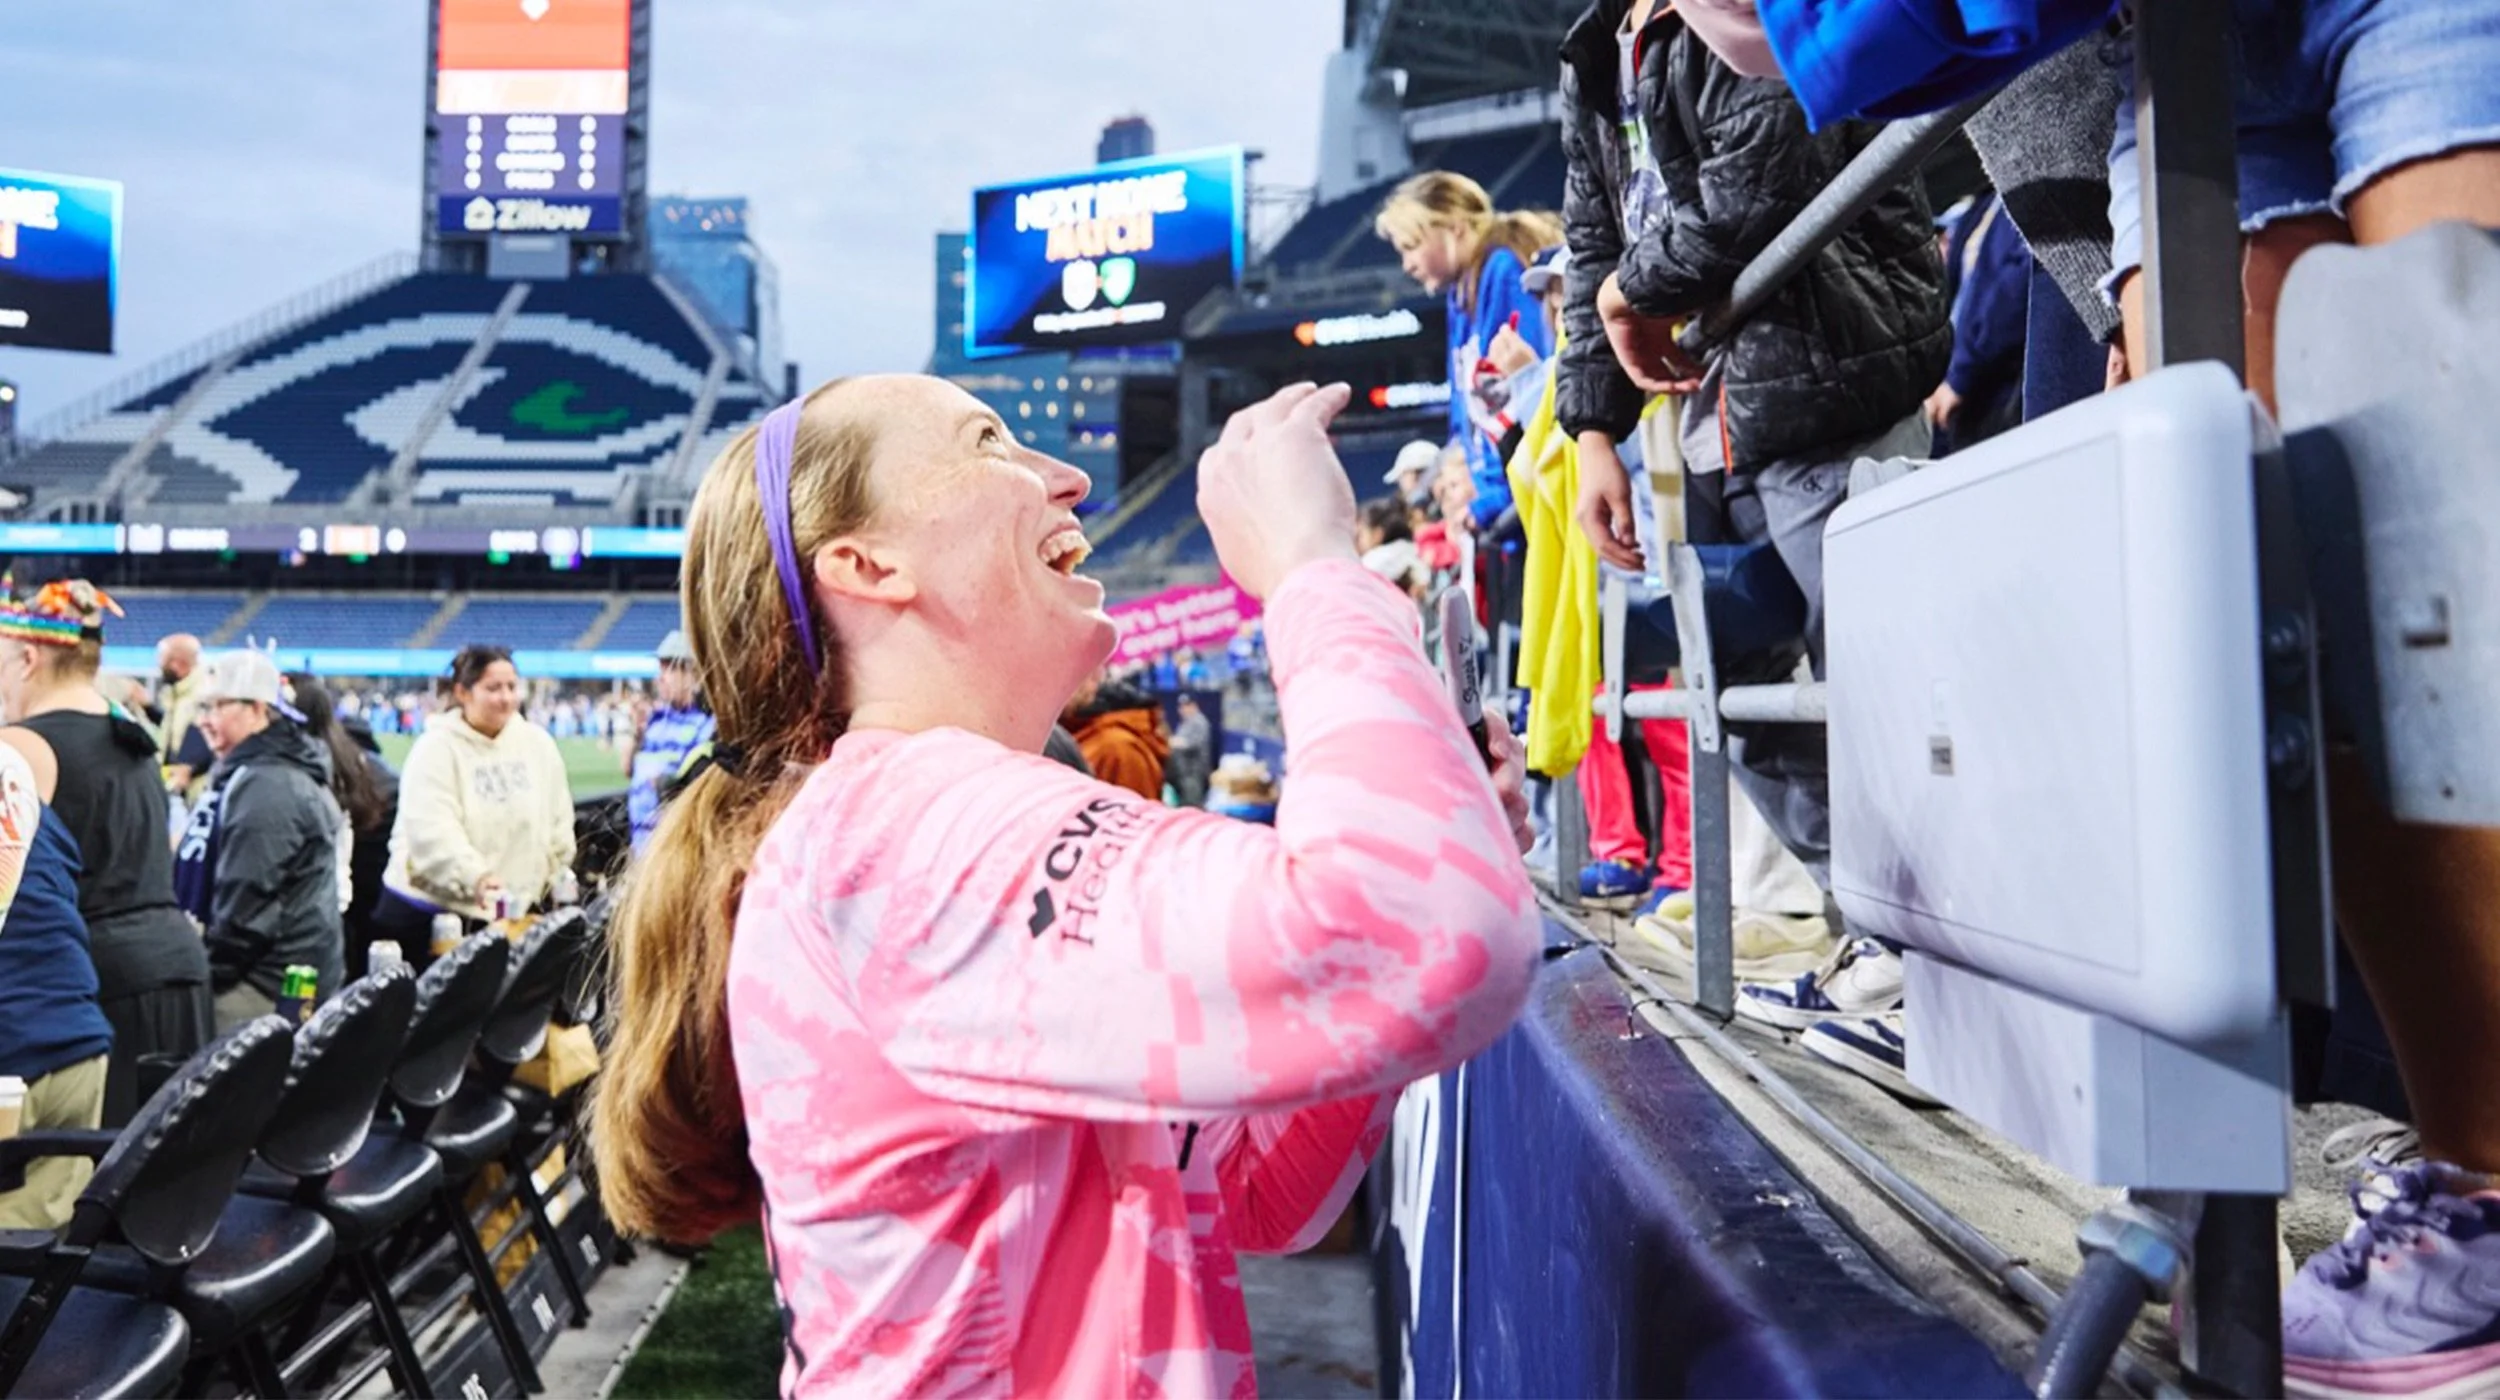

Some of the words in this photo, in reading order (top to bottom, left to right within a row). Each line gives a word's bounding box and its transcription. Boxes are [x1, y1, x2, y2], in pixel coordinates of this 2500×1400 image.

[496, 198, 592, 231] Zillow
[1014, 184, 1095, 232] NEXT
[1095, 170, 1187, 219] HOME
[1045, 798, 1127, 881] CVS
